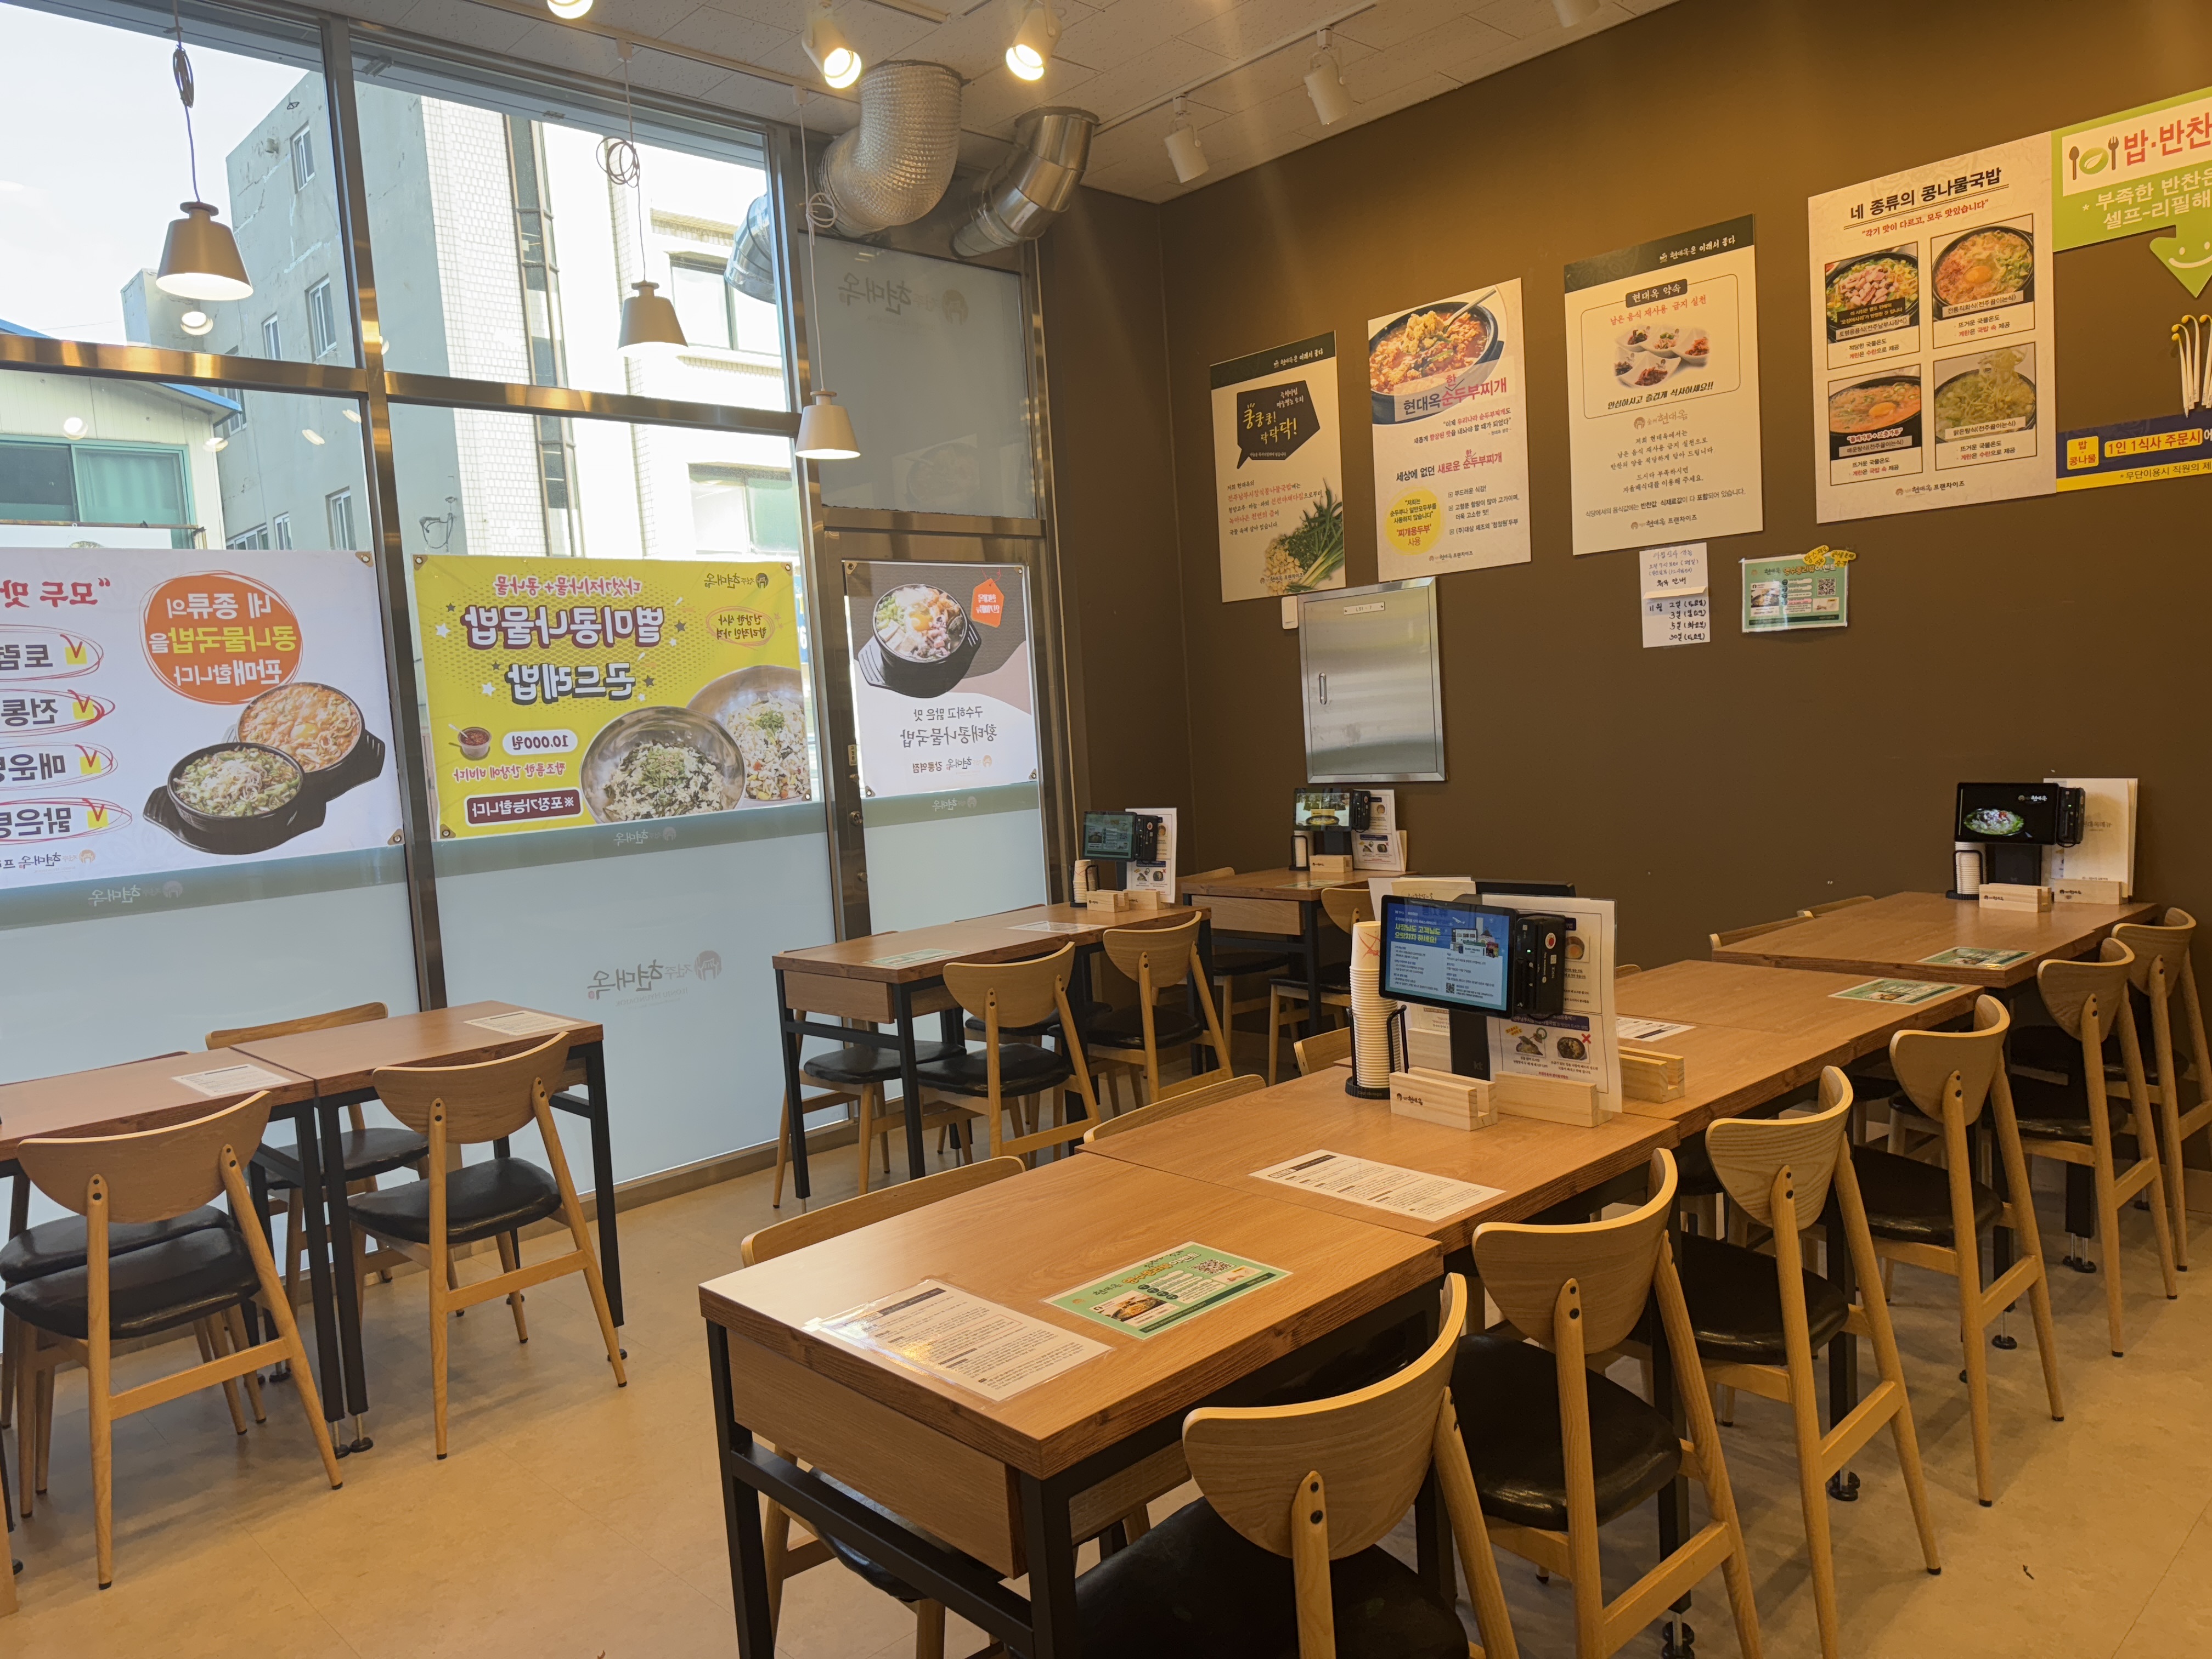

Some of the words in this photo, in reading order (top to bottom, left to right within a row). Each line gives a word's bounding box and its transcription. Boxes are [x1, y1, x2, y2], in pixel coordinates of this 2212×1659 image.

[1851, 204, 1864, 219] 네
[1870, 190, 1915, 216] 종류의
[1921, 167, 2002, 201] 콩나물국밥
[2096, 182, 2154, 211] 부족한
[1882, 222, 1898, 233] 맛이
[1927, 212, 1942, 222] 모두
[1699, 239, 1719, 252] 이래서
[1632, 289, 1660, 303] 현대옥
[1663, 283, 1681, 296] 약속
[1610, 314, 1625, 326] 남은
[1644, 304, 1668, 317] 재사용
[1672, 299, 1688, 311] 금지
[1691, 295, 1707, 306] 실천
[1607, 395, 1643, 409] 안심하시고
[1458, 414, 1478, 425] 우리나라
[1667, 441, 1679, 449] 금지
[2079, 441, 2087, 449] 밥
[2108, 441, 2126, 455] 1인
[2132, 436, 2162, 451] 1식사
[2165, 430, 2200, 447] 주문시
[2069, 454, 2097, 466] 콩나물
[1396, 469, 1418, 481] 세상에
[1420, 466, 1435, 477] 없던
[1438, 461, 1460, 473] 새로운
[1637, 472, 1655, 481] 드시다
[1657, 466, 1689, 477] 부족하시면
[2172, 463, 2199, 474] 직원의
[1455, 488, 1474, 496] 부드러운
[1408, 537, 1421, 546] 사용
